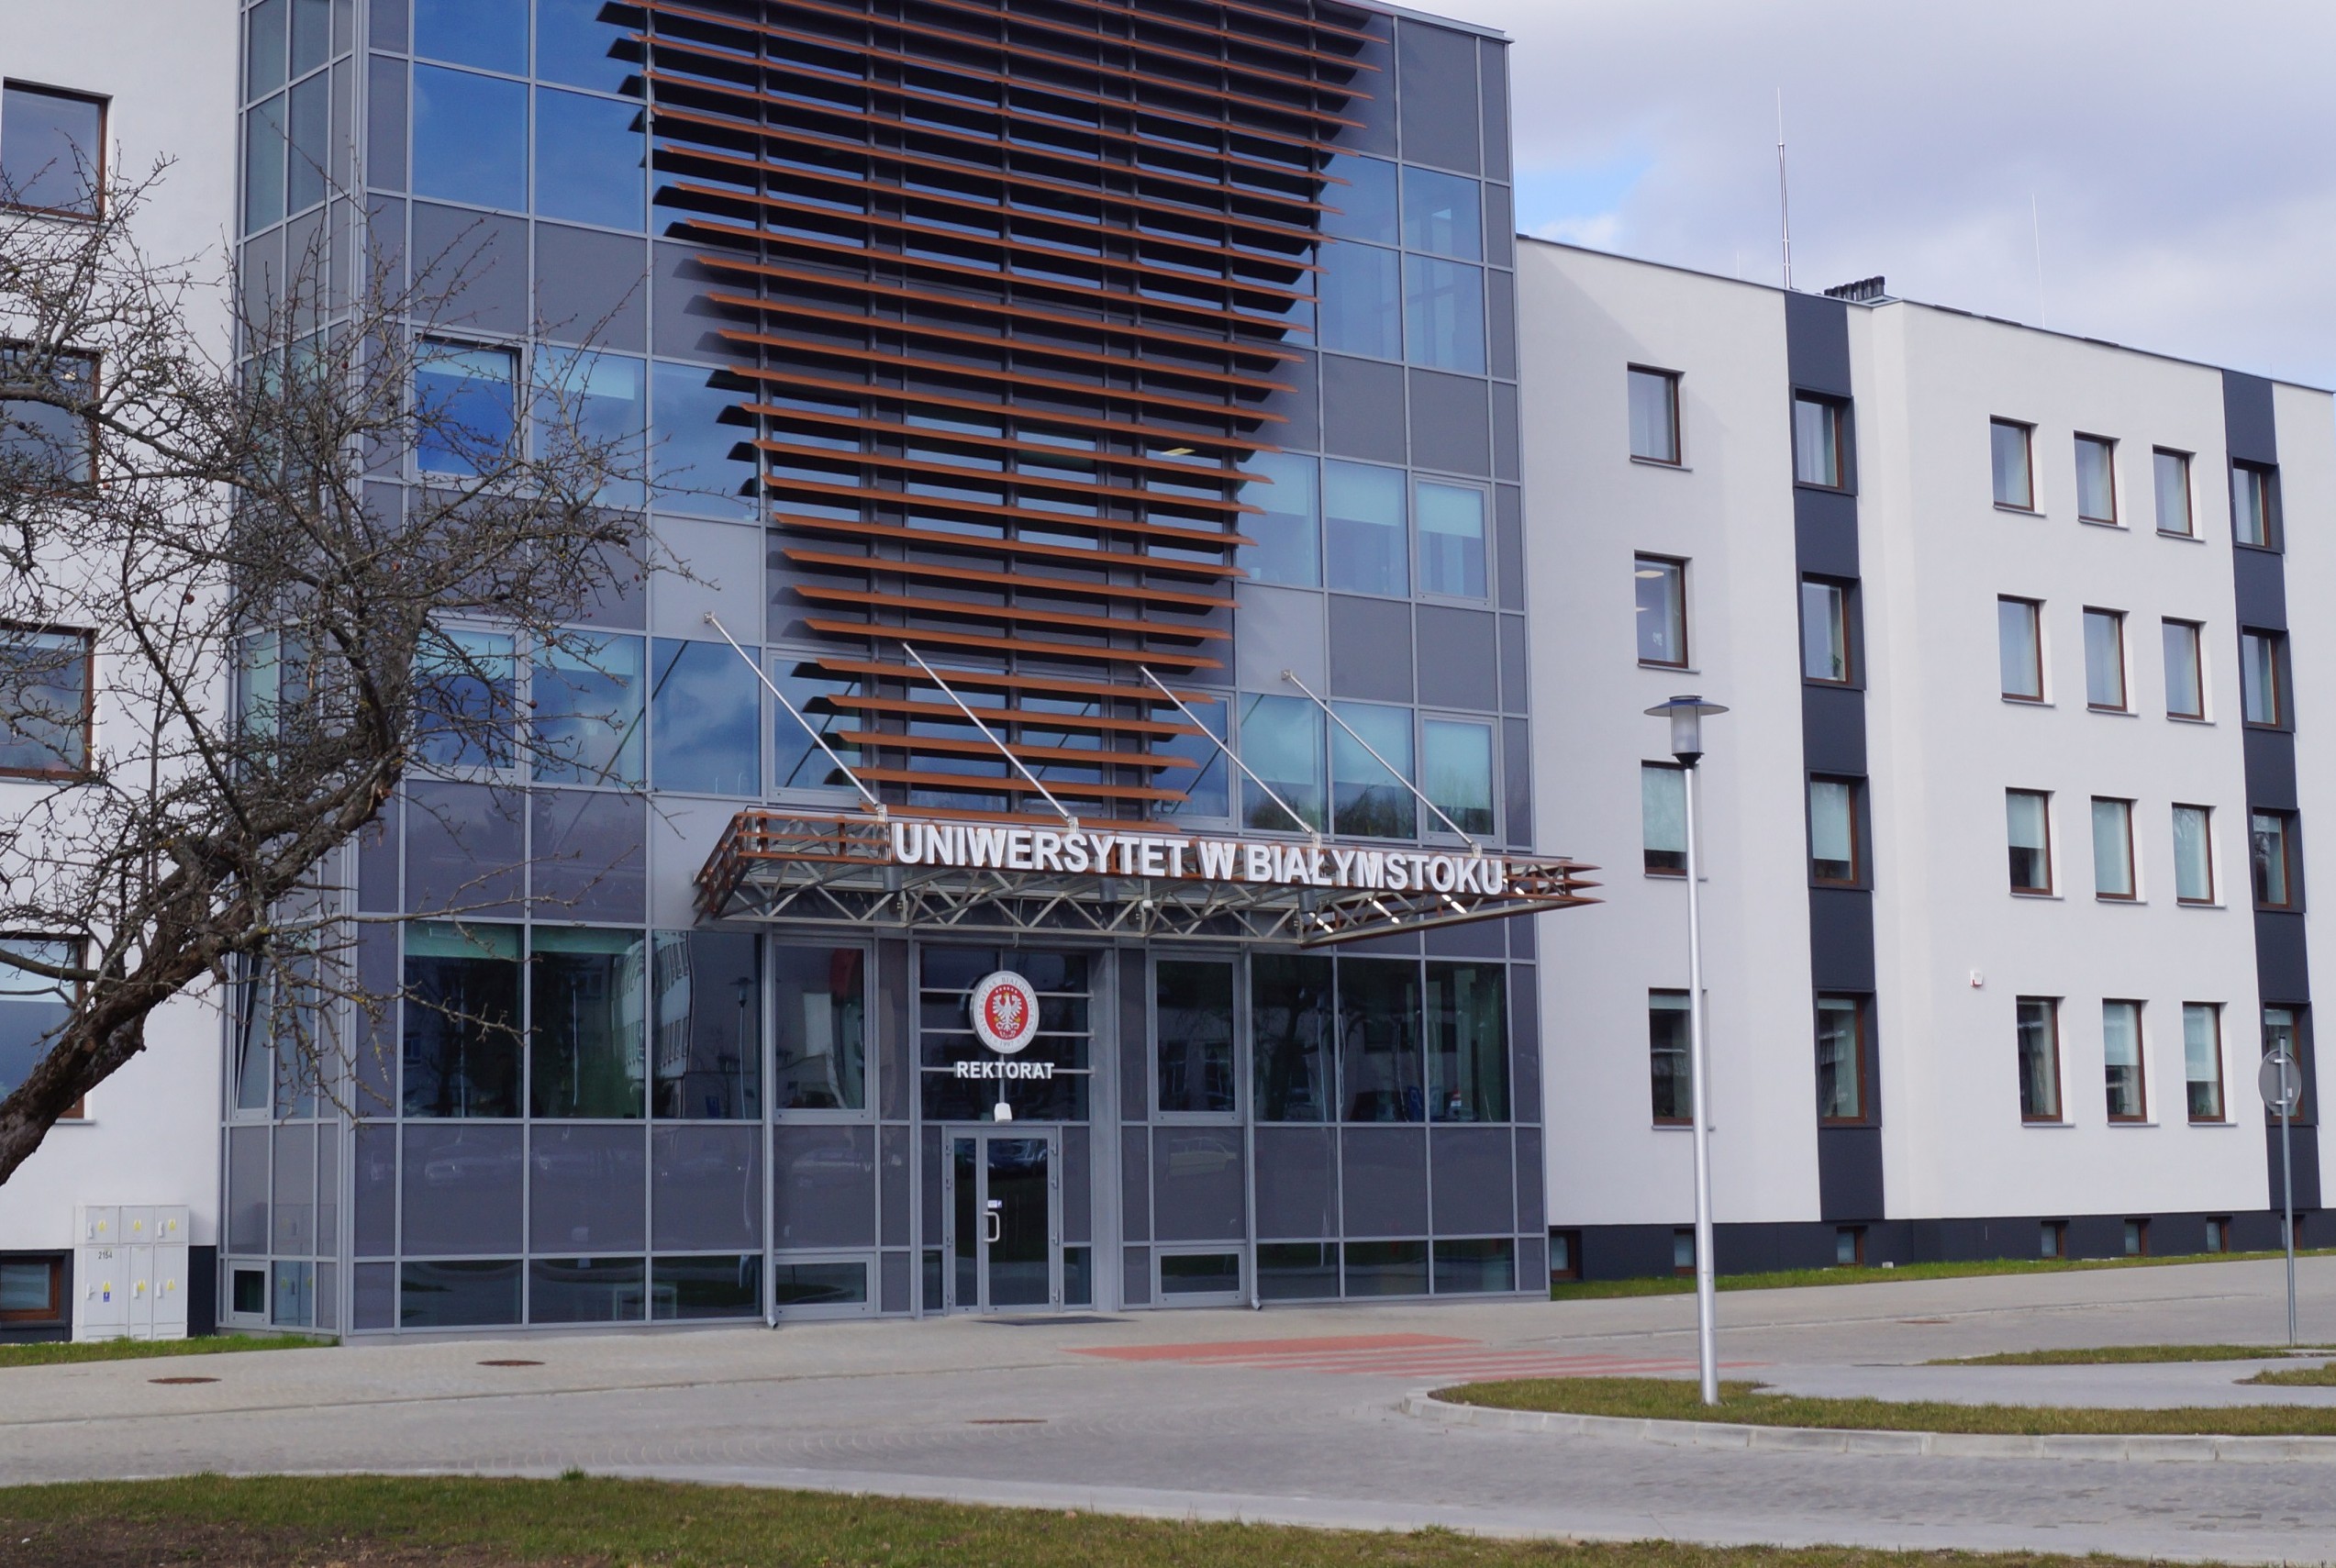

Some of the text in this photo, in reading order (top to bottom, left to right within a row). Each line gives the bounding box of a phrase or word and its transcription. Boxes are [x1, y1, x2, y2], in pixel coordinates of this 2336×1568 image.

[891, 822, 1503, 895] UNIWERSYTET W BIAŁYMSTOKU
[955, 1062, 1054, 1079] REKTORAT
